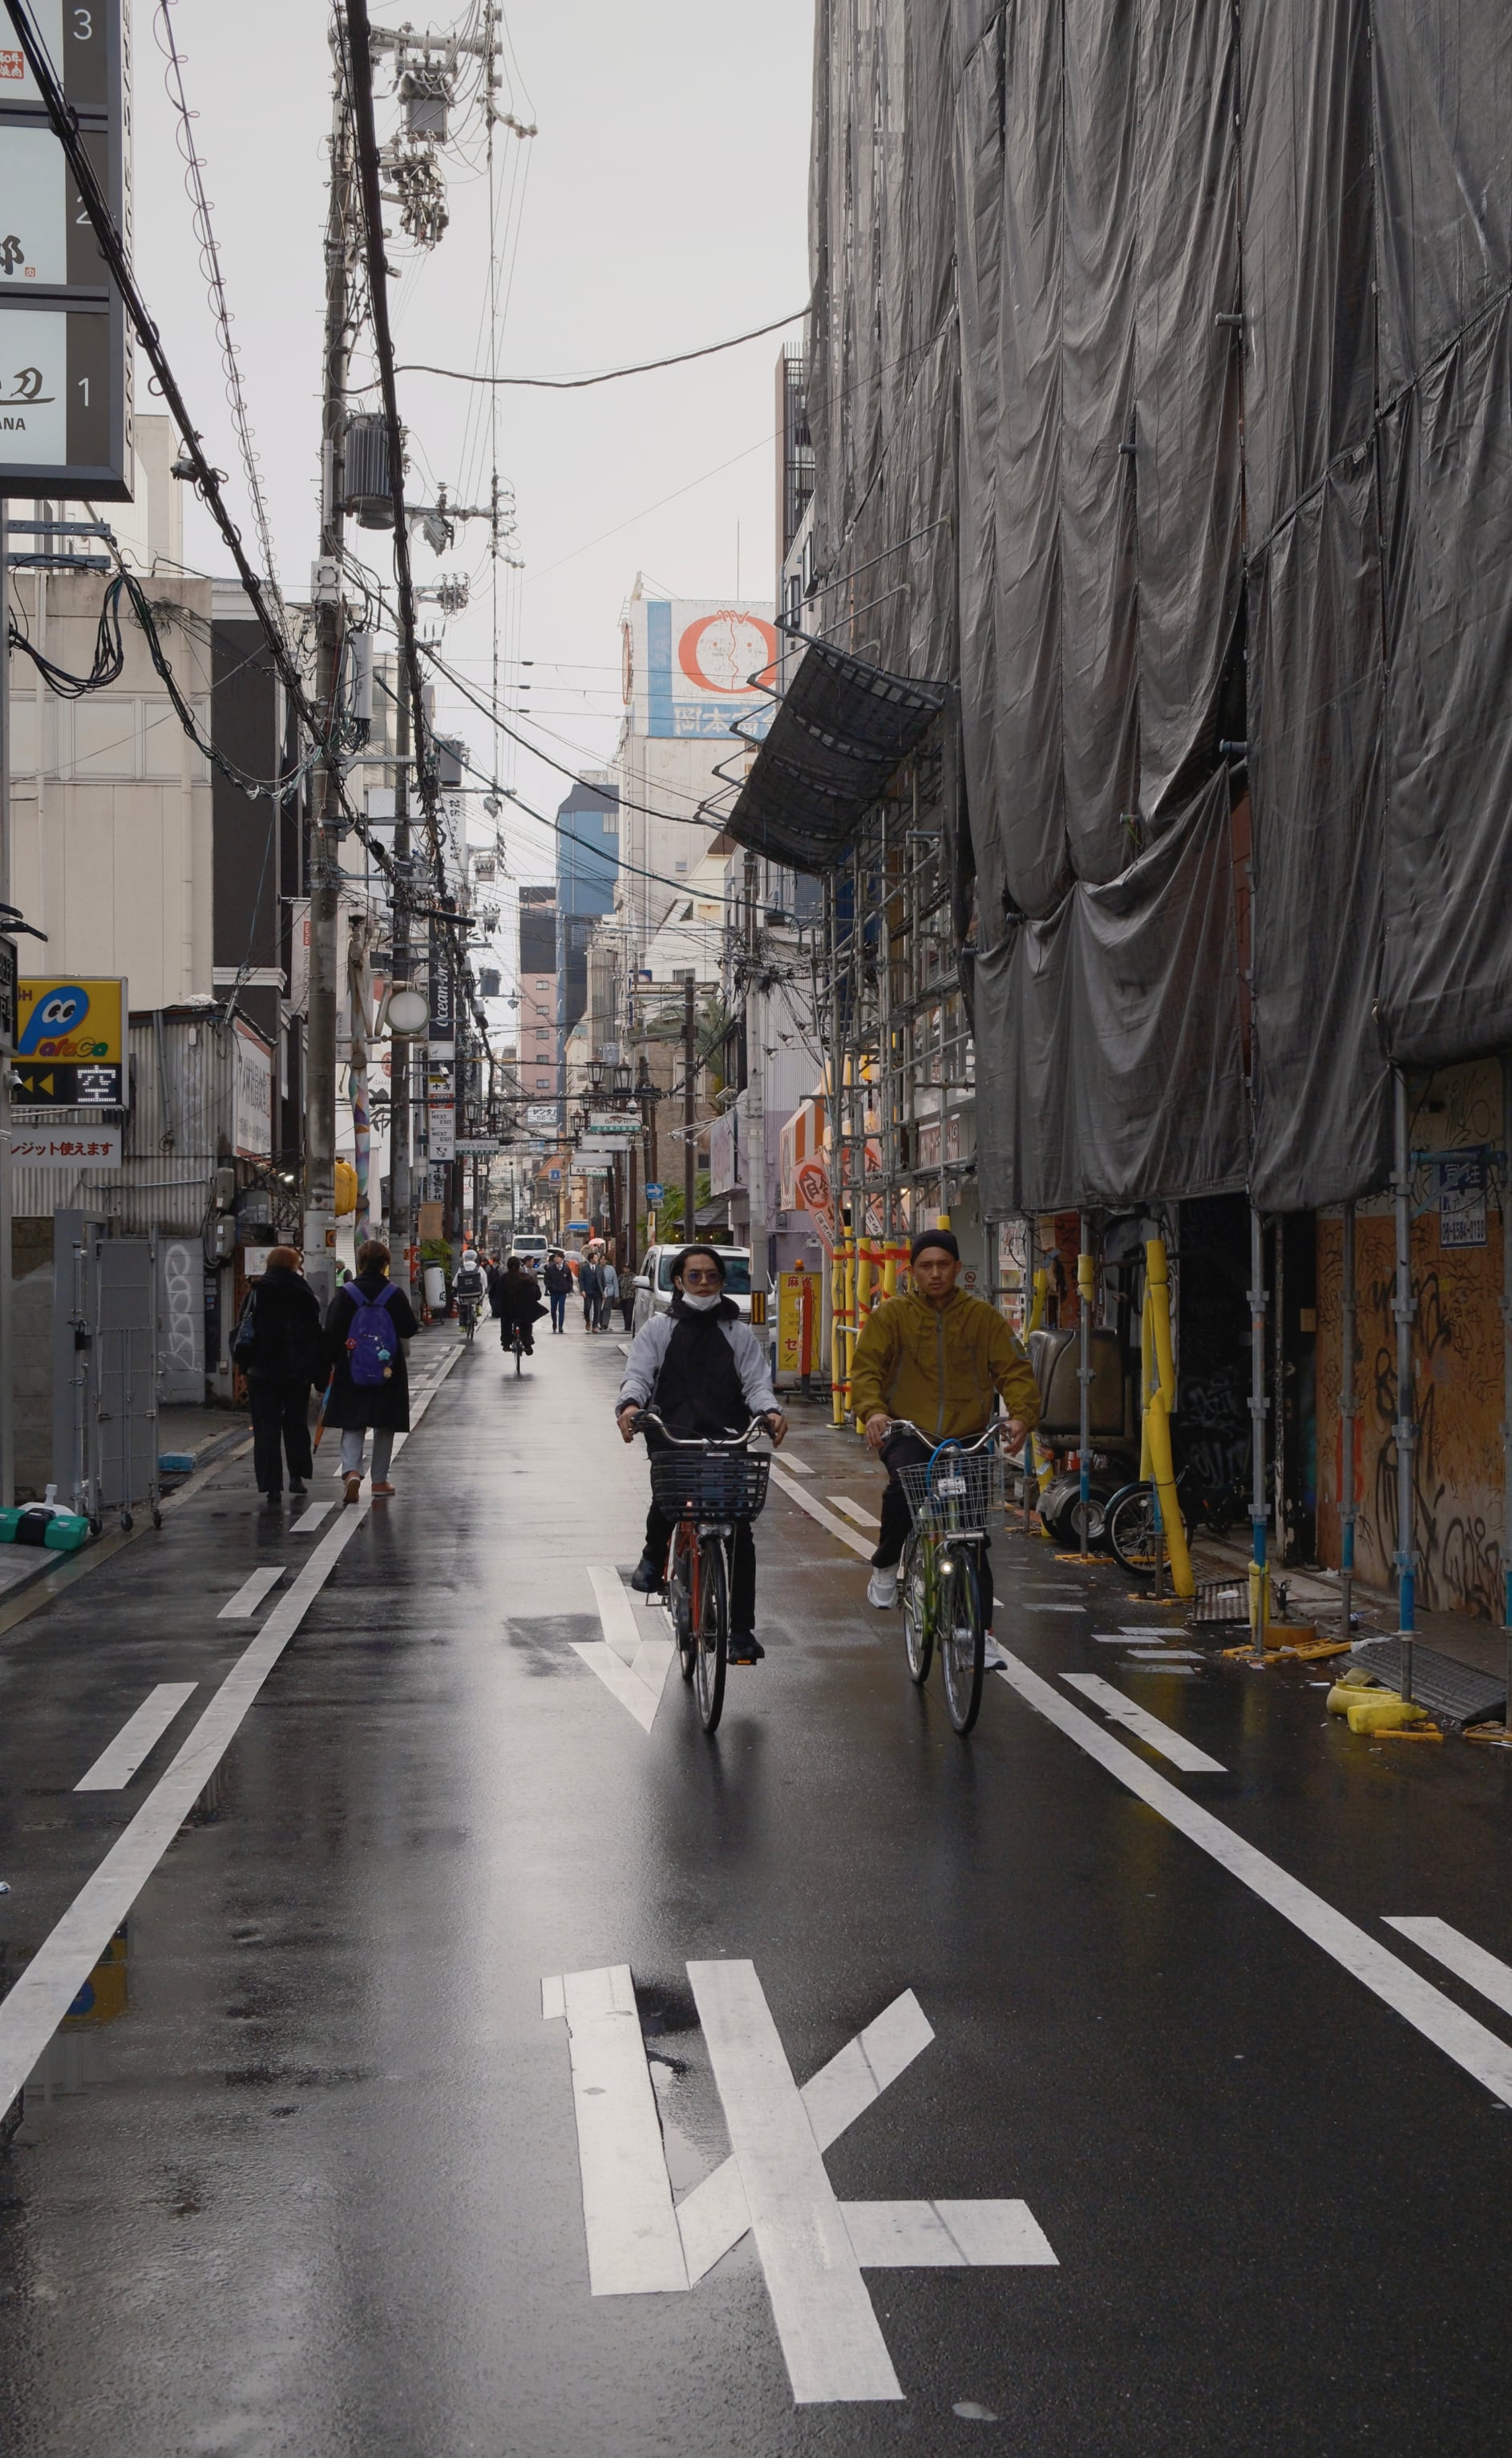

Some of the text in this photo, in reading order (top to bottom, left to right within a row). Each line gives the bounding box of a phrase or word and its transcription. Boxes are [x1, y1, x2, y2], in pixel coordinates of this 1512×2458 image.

[73, 9, 92, 39] 3
[79, 378, 89, 406] 1
[0, 418, 26, 431] NA
[78, 1065, 116, 1102] 空
[787, 1275, 813, 1288] 麻雀
